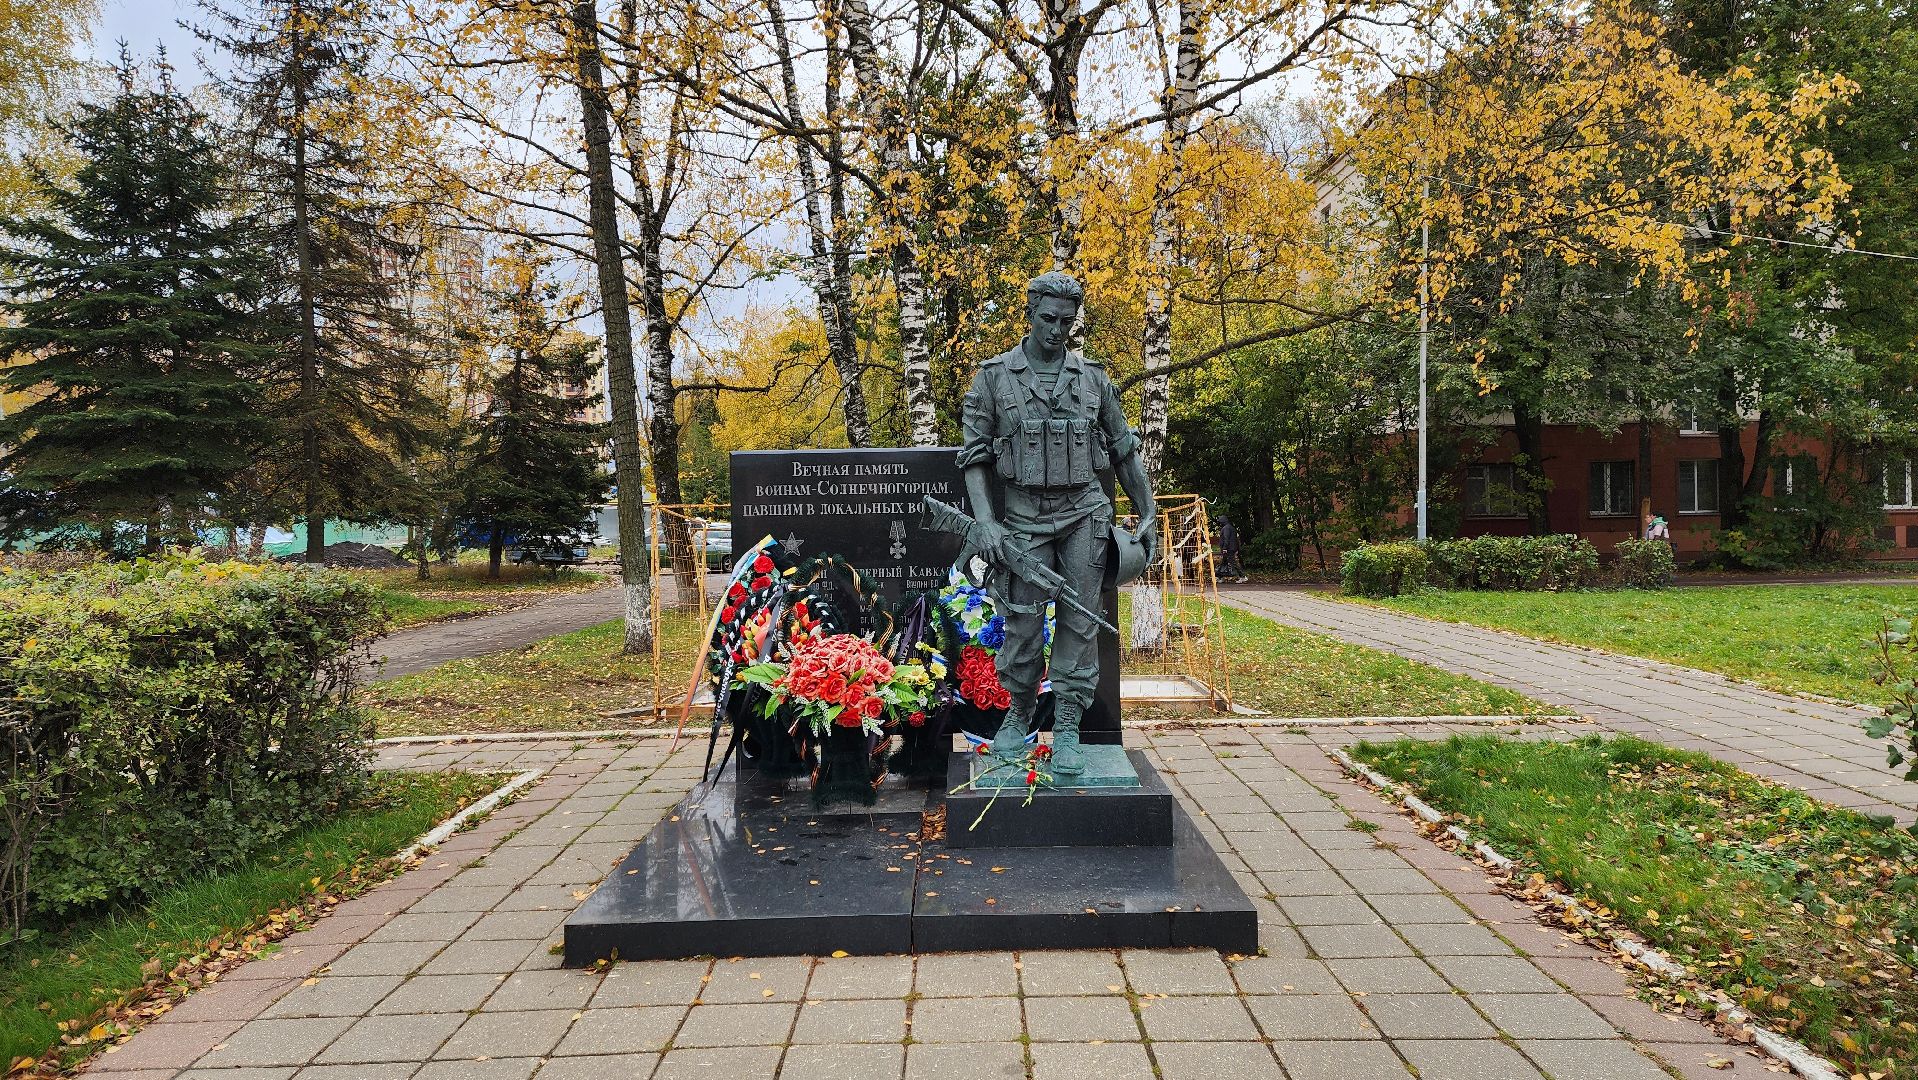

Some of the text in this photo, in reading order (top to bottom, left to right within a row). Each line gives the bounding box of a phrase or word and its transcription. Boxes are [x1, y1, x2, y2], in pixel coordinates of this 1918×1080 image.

[791, 461, 909, 477] ВЕЧНАЯ ПАМЯТЬ
[741, 502, 804, 517] ПАВШИМ
[806, 502, 816, 516] В
[820, 501, 905, 516] ЛОКАЛЬНЫХ
